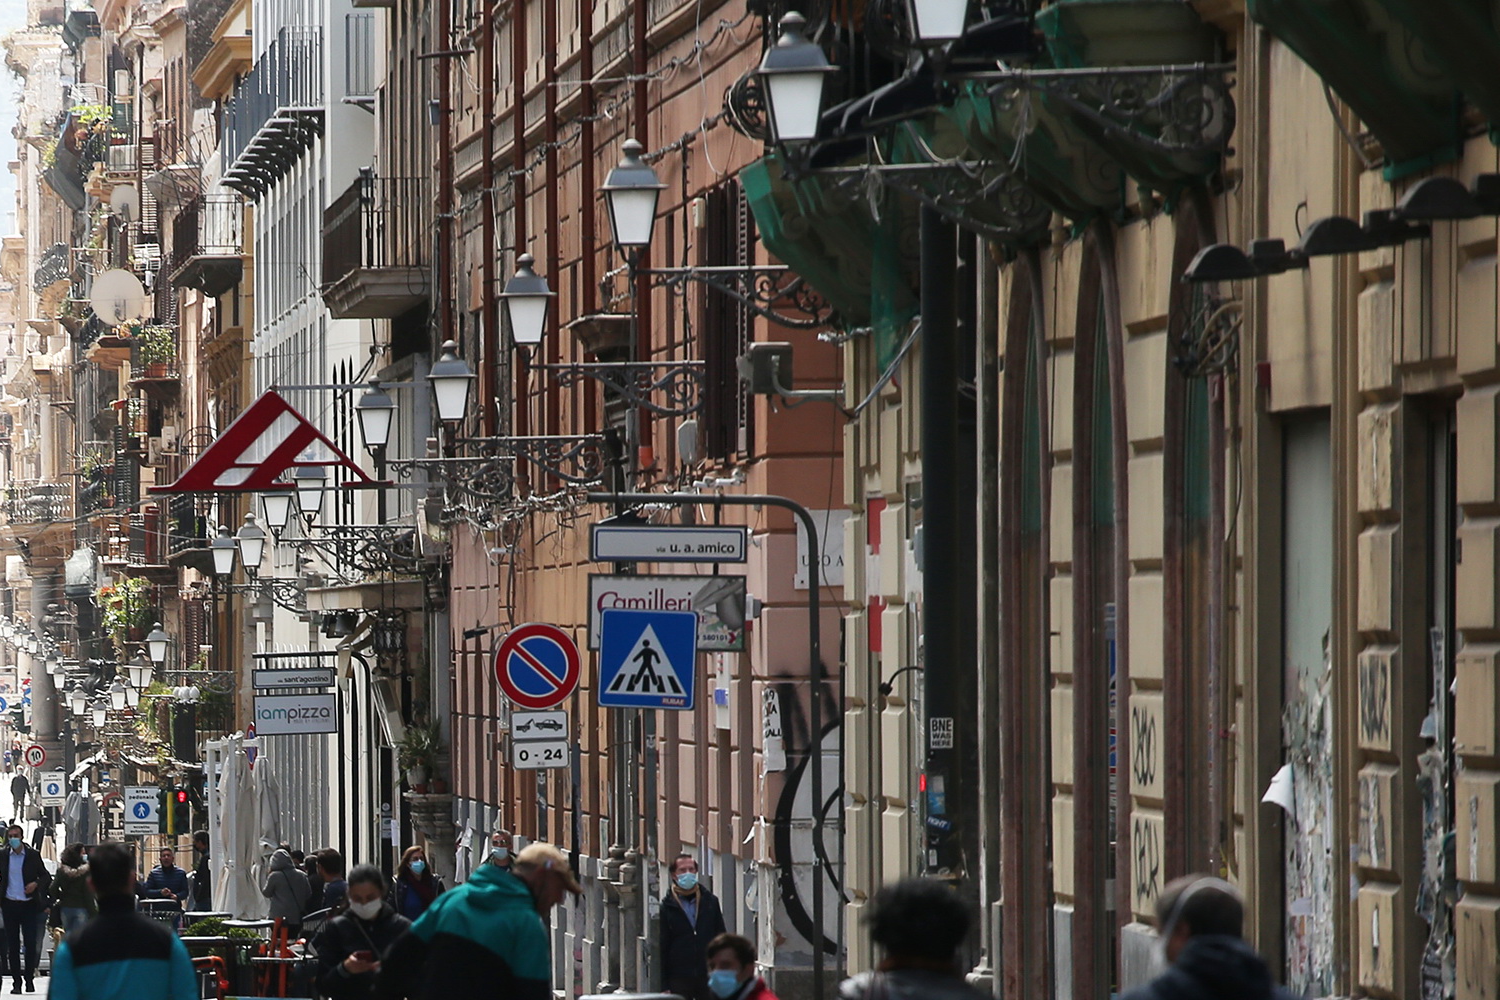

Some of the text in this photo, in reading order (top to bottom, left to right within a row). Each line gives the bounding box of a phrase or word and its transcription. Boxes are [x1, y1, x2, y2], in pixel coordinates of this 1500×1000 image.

[670, 543, 681, 553] u.
[684, 543, 694, 553] a.
[697, 541, 735, 554] amico
[596, 588, 692, 614] Camilleri
[257, 704, 330, 724] iampizza
[931, 719, 952, 732] BNE
[31, 750, 41, 762] 10
[544, 749, 563, 760] 24
